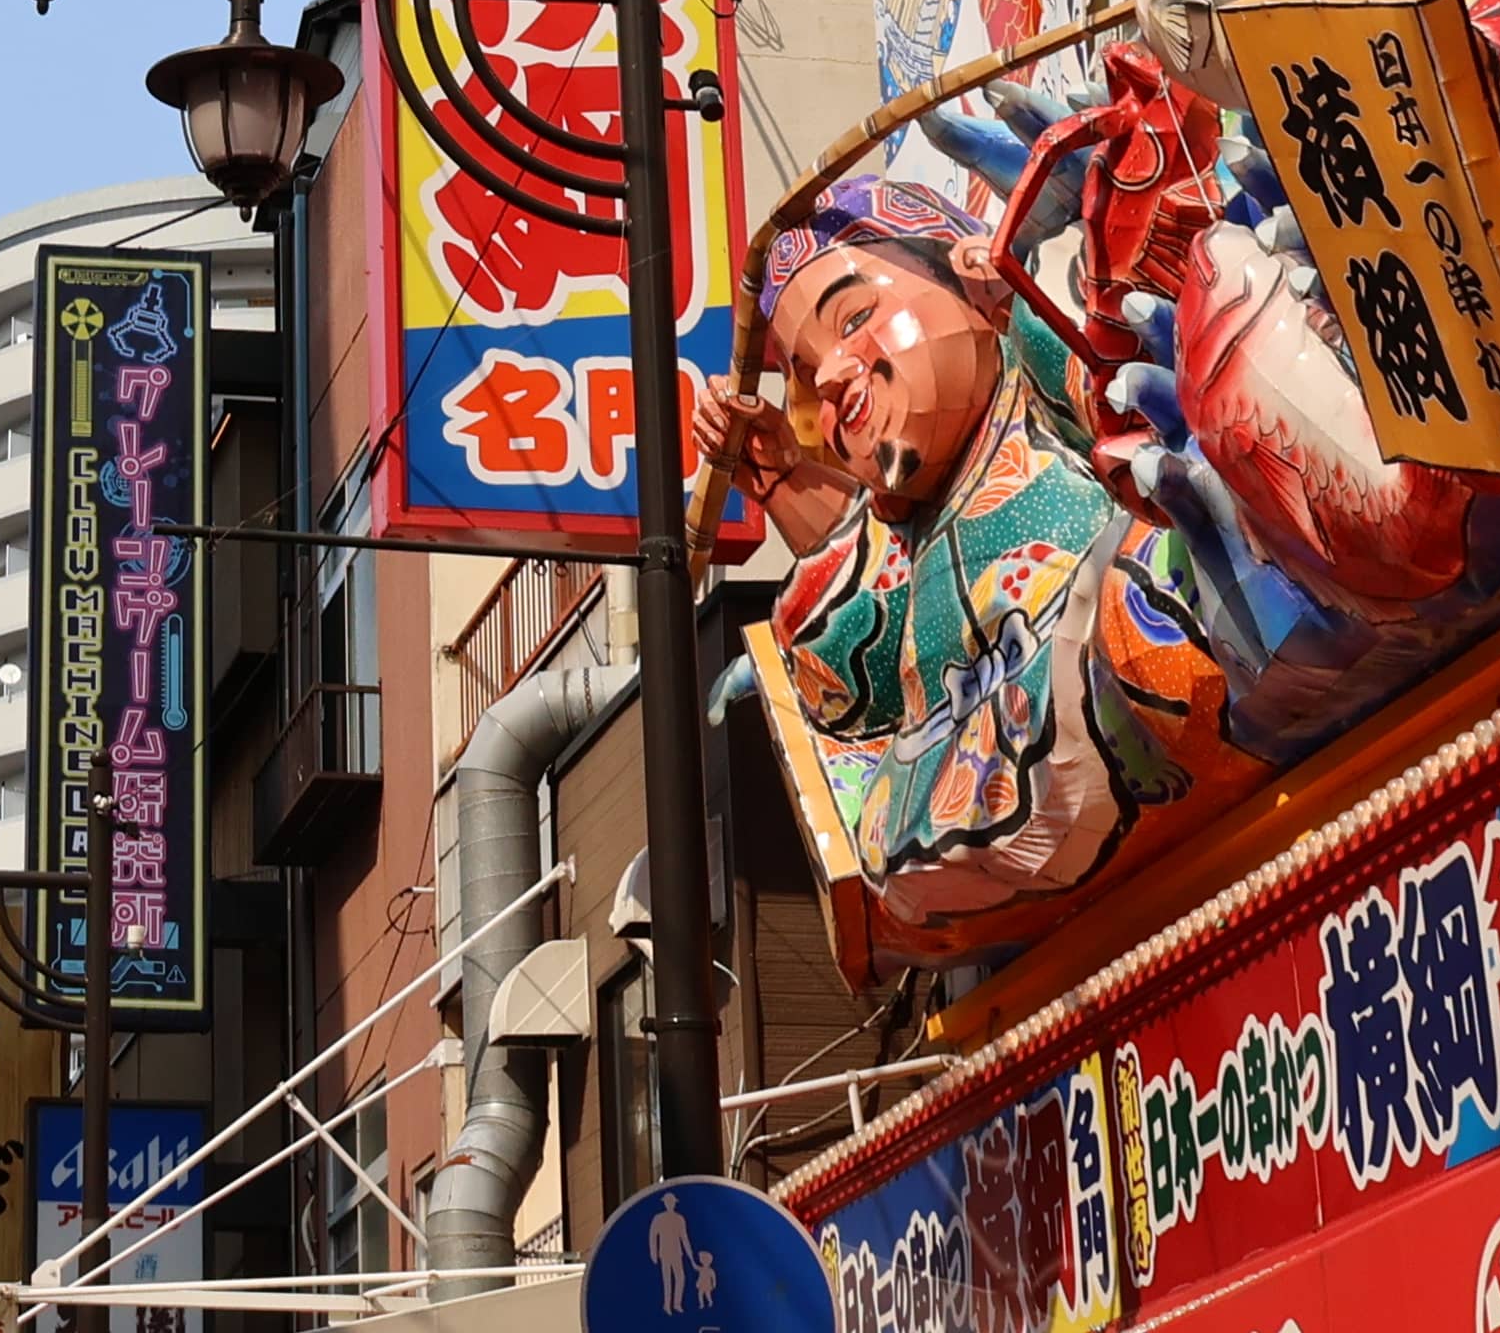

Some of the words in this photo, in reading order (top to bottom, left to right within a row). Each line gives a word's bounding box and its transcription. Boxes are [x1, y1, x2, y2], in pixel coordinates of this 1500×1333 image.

[1272, 57, 1469, 425] 横綱
[66, 449, 99, 581] CLAW
[60, 585, 104, 777] MACHINE
[1327, 855, 1499, 1171] 横綱
[1071, 1088, 1111, 1304] 名門
[1117, 1060, 1154, 1271] 新世界
[1149, 1025, 1328, 1223] 日本一の串かつ
